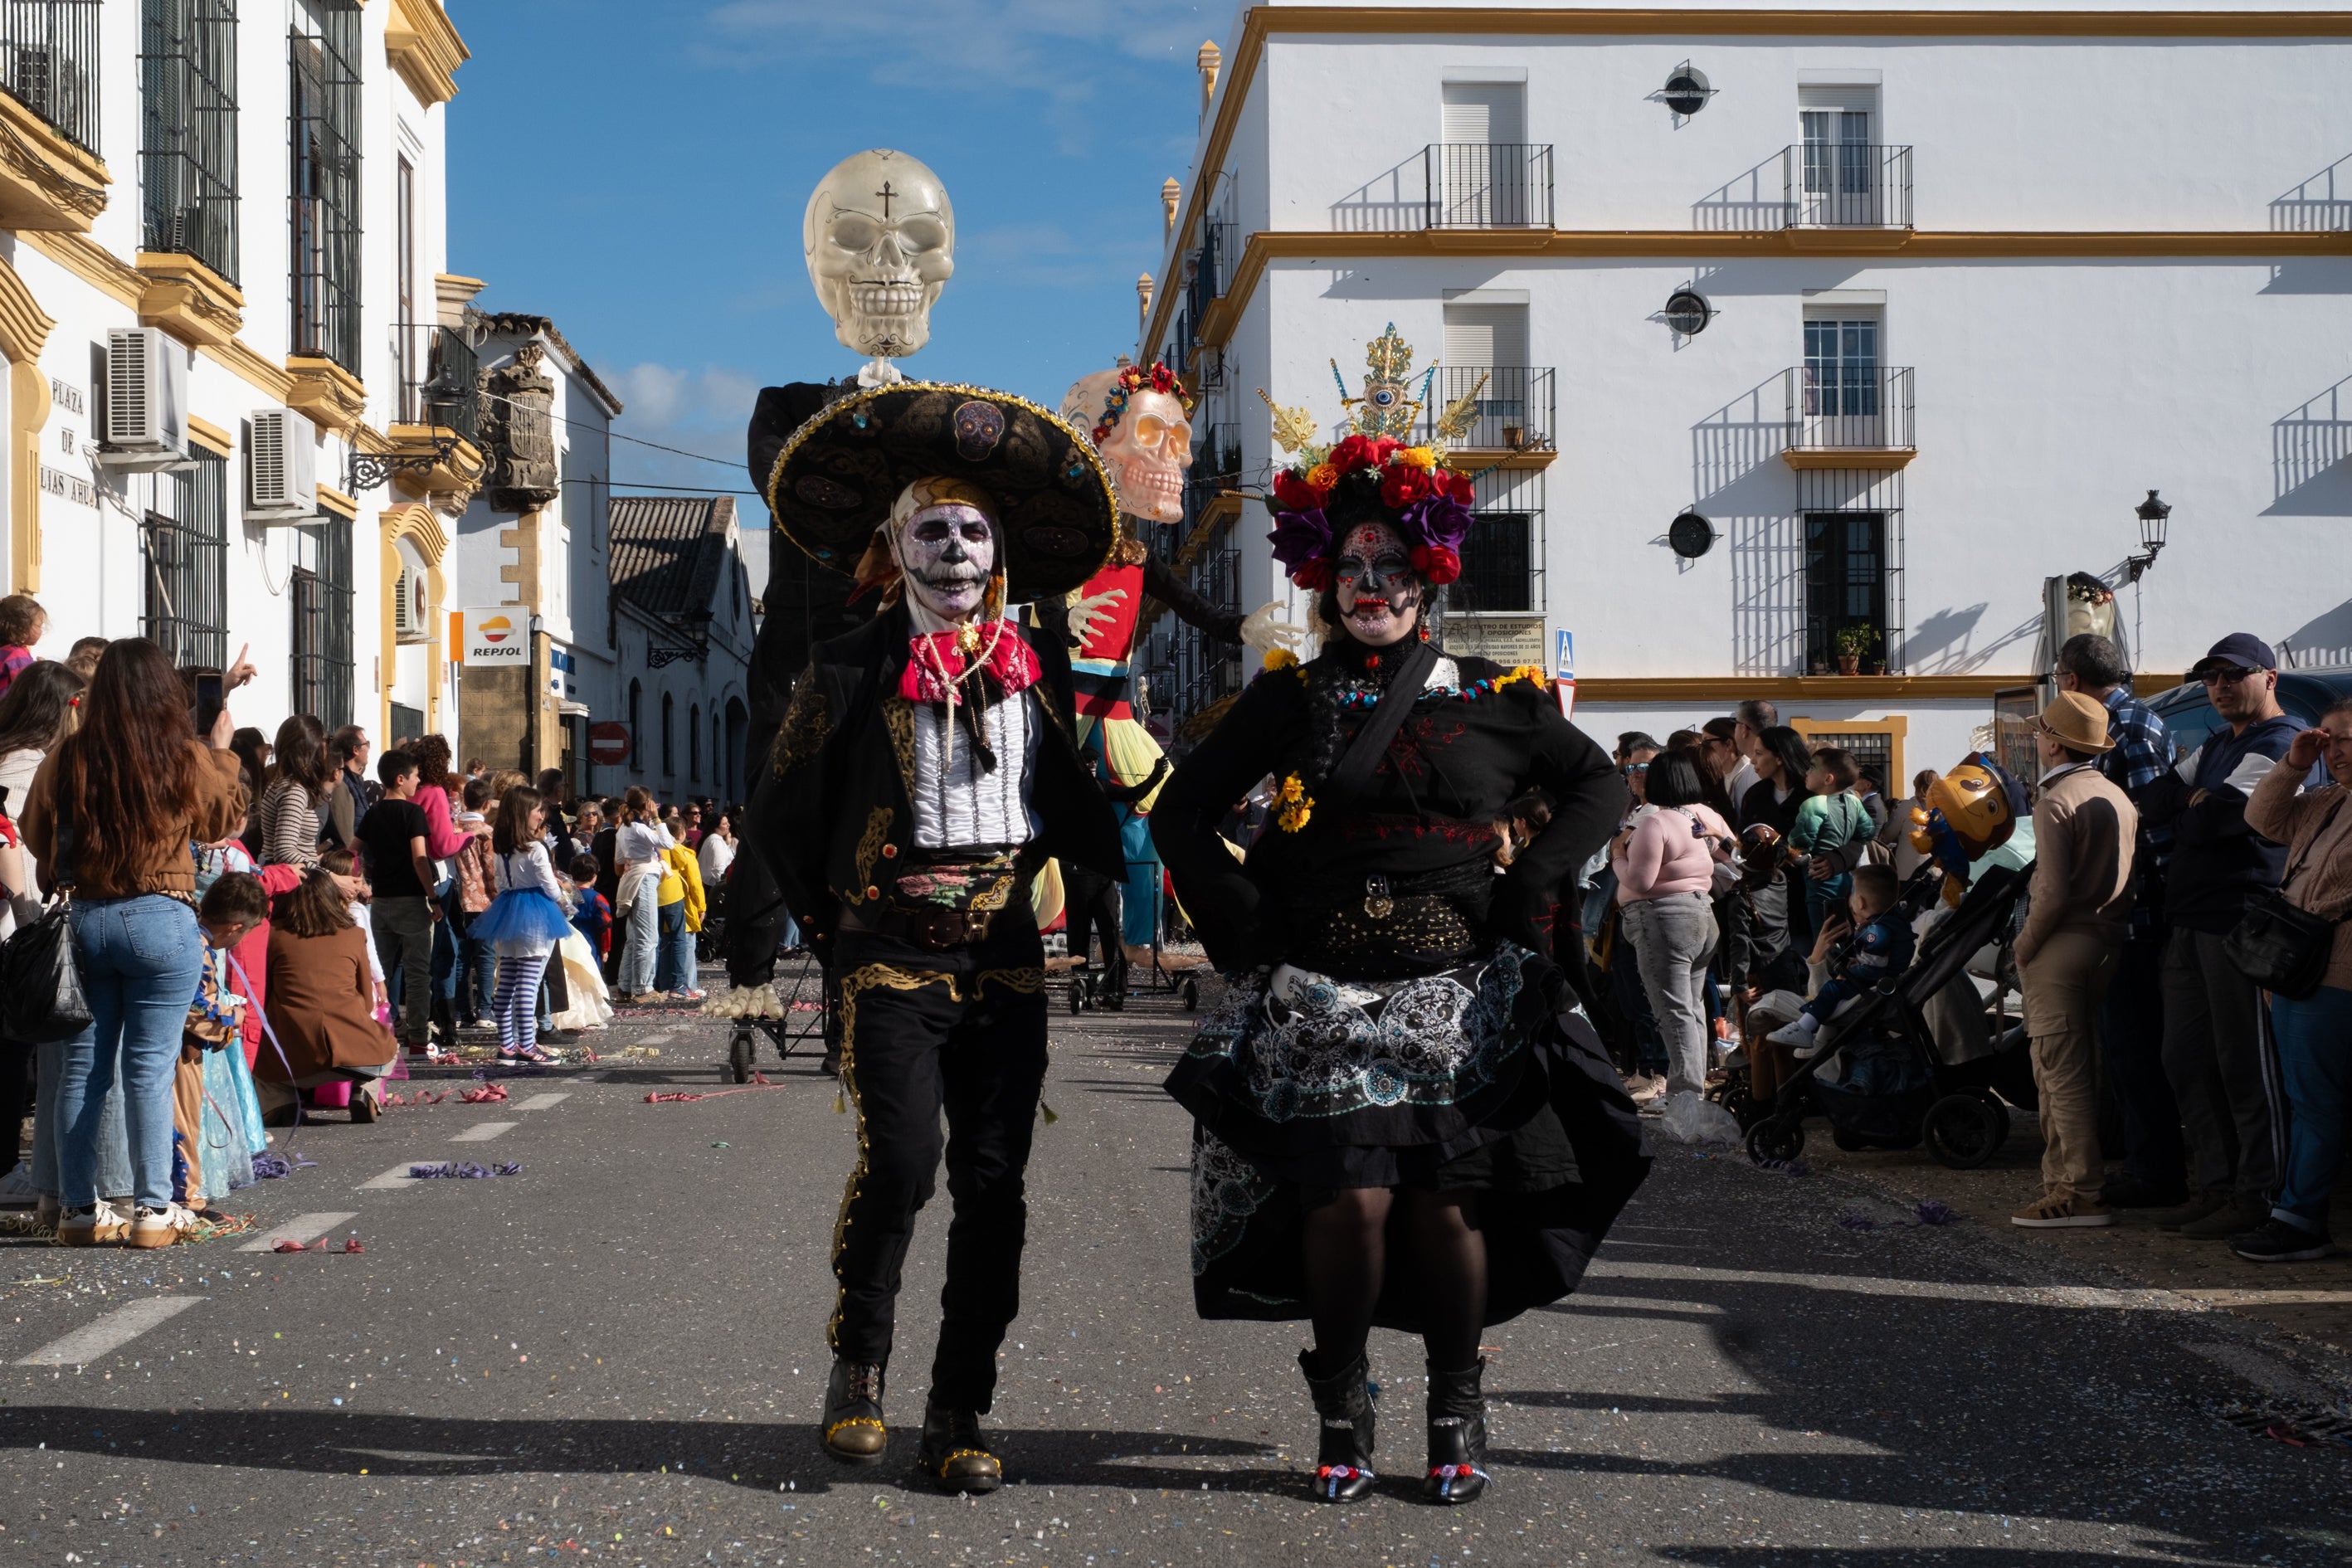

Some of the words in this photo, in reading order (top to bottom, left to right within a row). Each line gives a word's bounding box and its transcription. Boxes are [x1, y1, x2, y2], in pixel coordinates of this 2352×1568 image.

[52, 380, 83, 415] PLAZA
[61, 431, 74, 455] DE
[41, 467, 65, 496] LIAS
[473, 647, 522, 656] REPSOL
